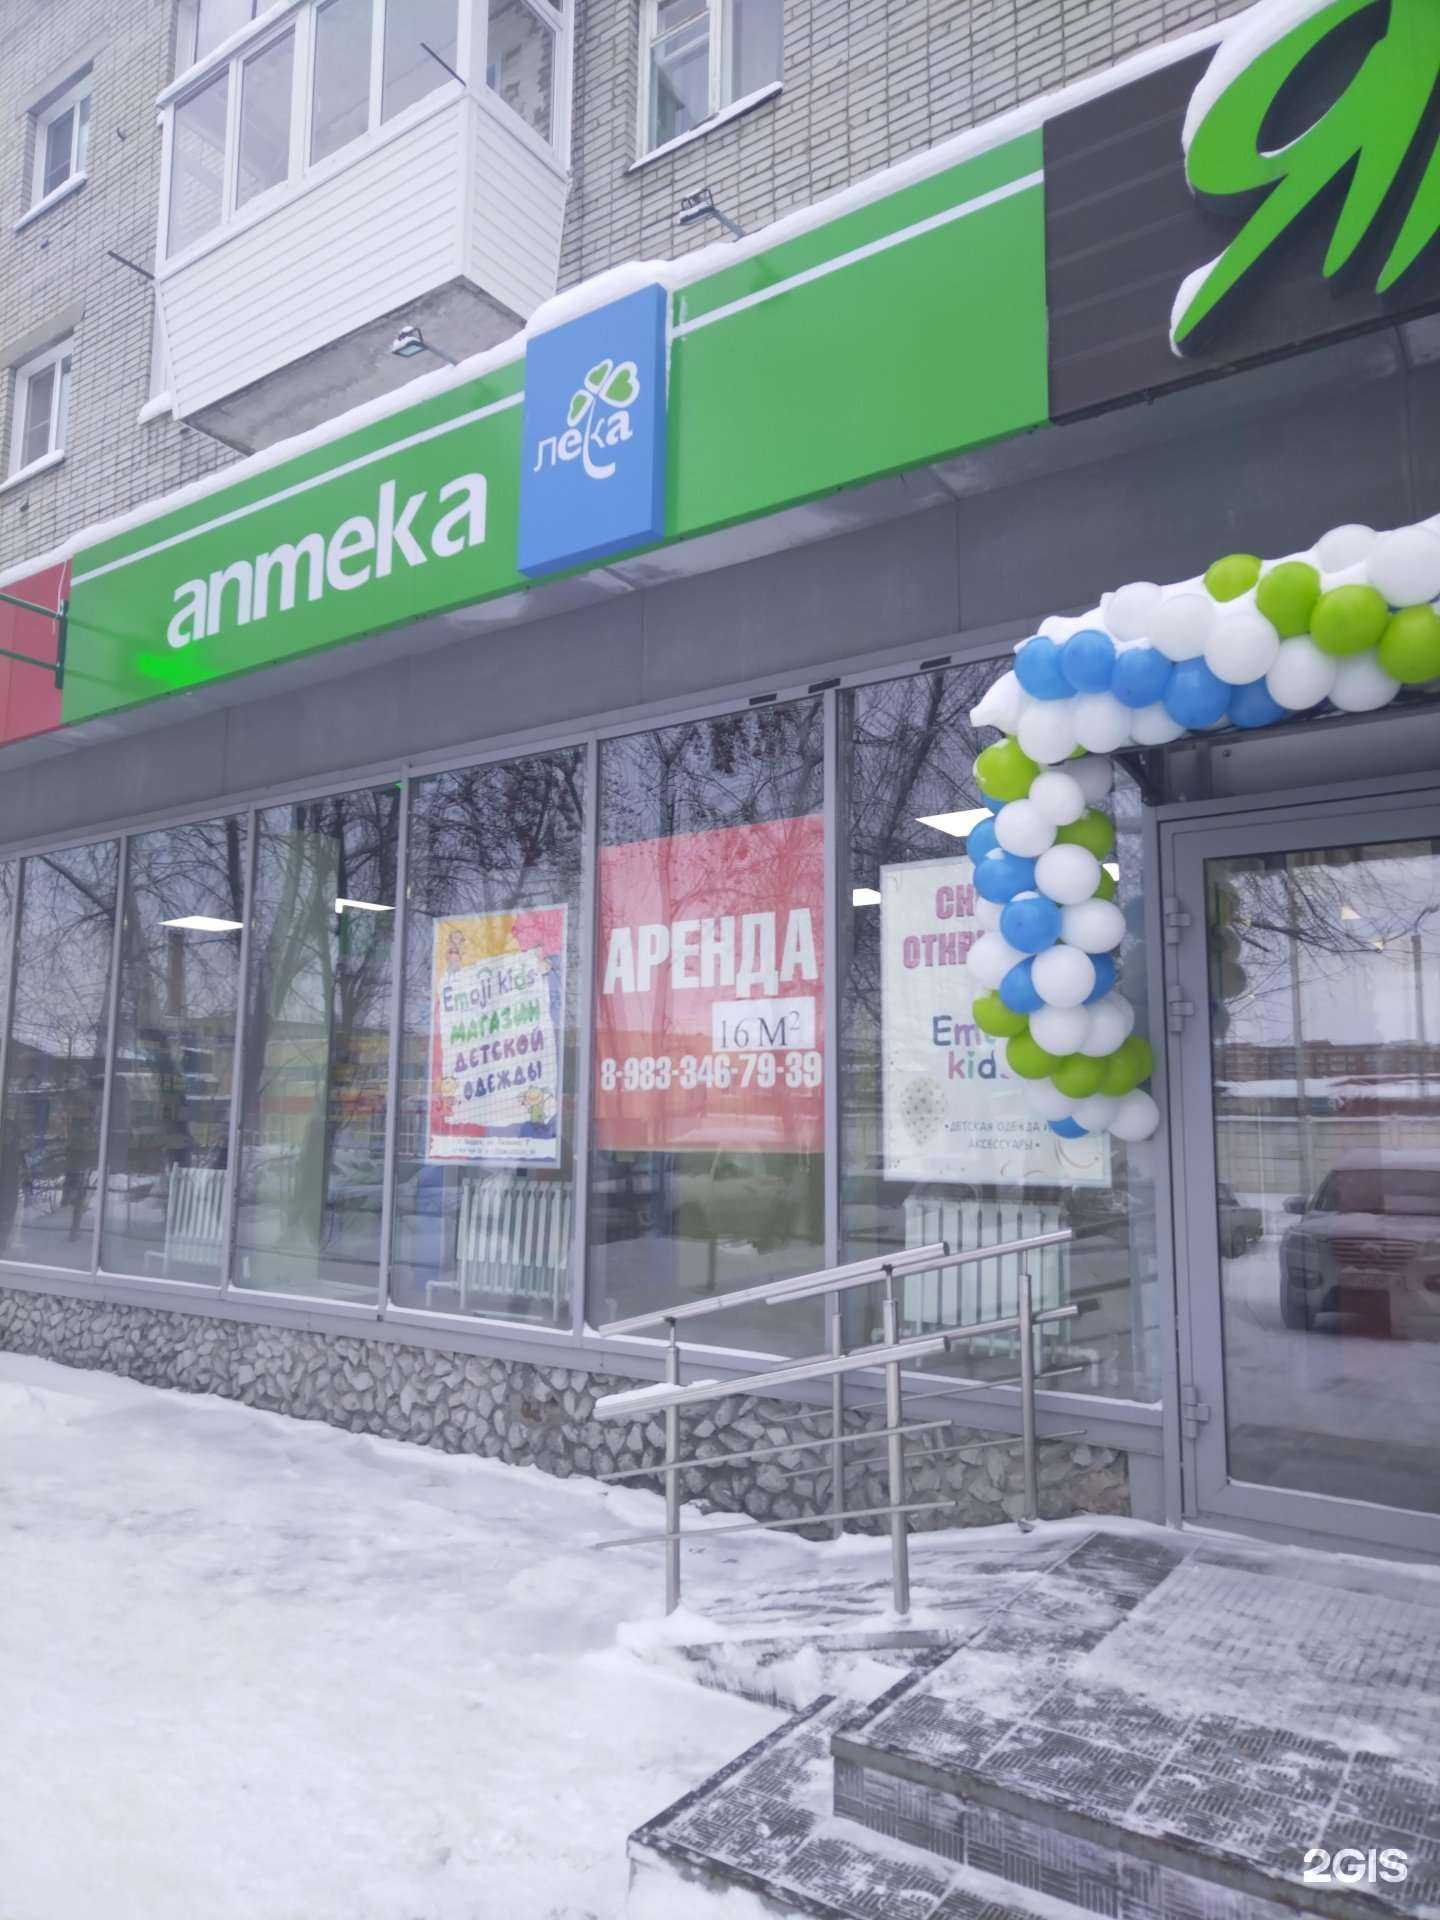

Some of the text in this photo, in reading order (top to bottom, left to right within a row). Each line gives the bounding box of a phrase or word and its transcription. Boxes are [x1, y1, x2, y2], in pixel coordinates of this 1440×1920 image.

[602, 907, 819, 999] АРЕНДА
[902, 930, 986, 969] ОТКР
[443, 964, 537, 1012] Emoji kids
[450, 998, 540, 1045] МАГАЗИН
[720, 1017, 750, 1049] 16
[933, 1015, 996, 1047] Em
[454, 1026, 544, 1073] ДЕТСКОЙ
[948, 1050, 1009, 1080] kid
[463, 1060, 542, 1101] ОДЕЖДЫ
[600, 1051, 823, 1092] 8-983-346-79-39
